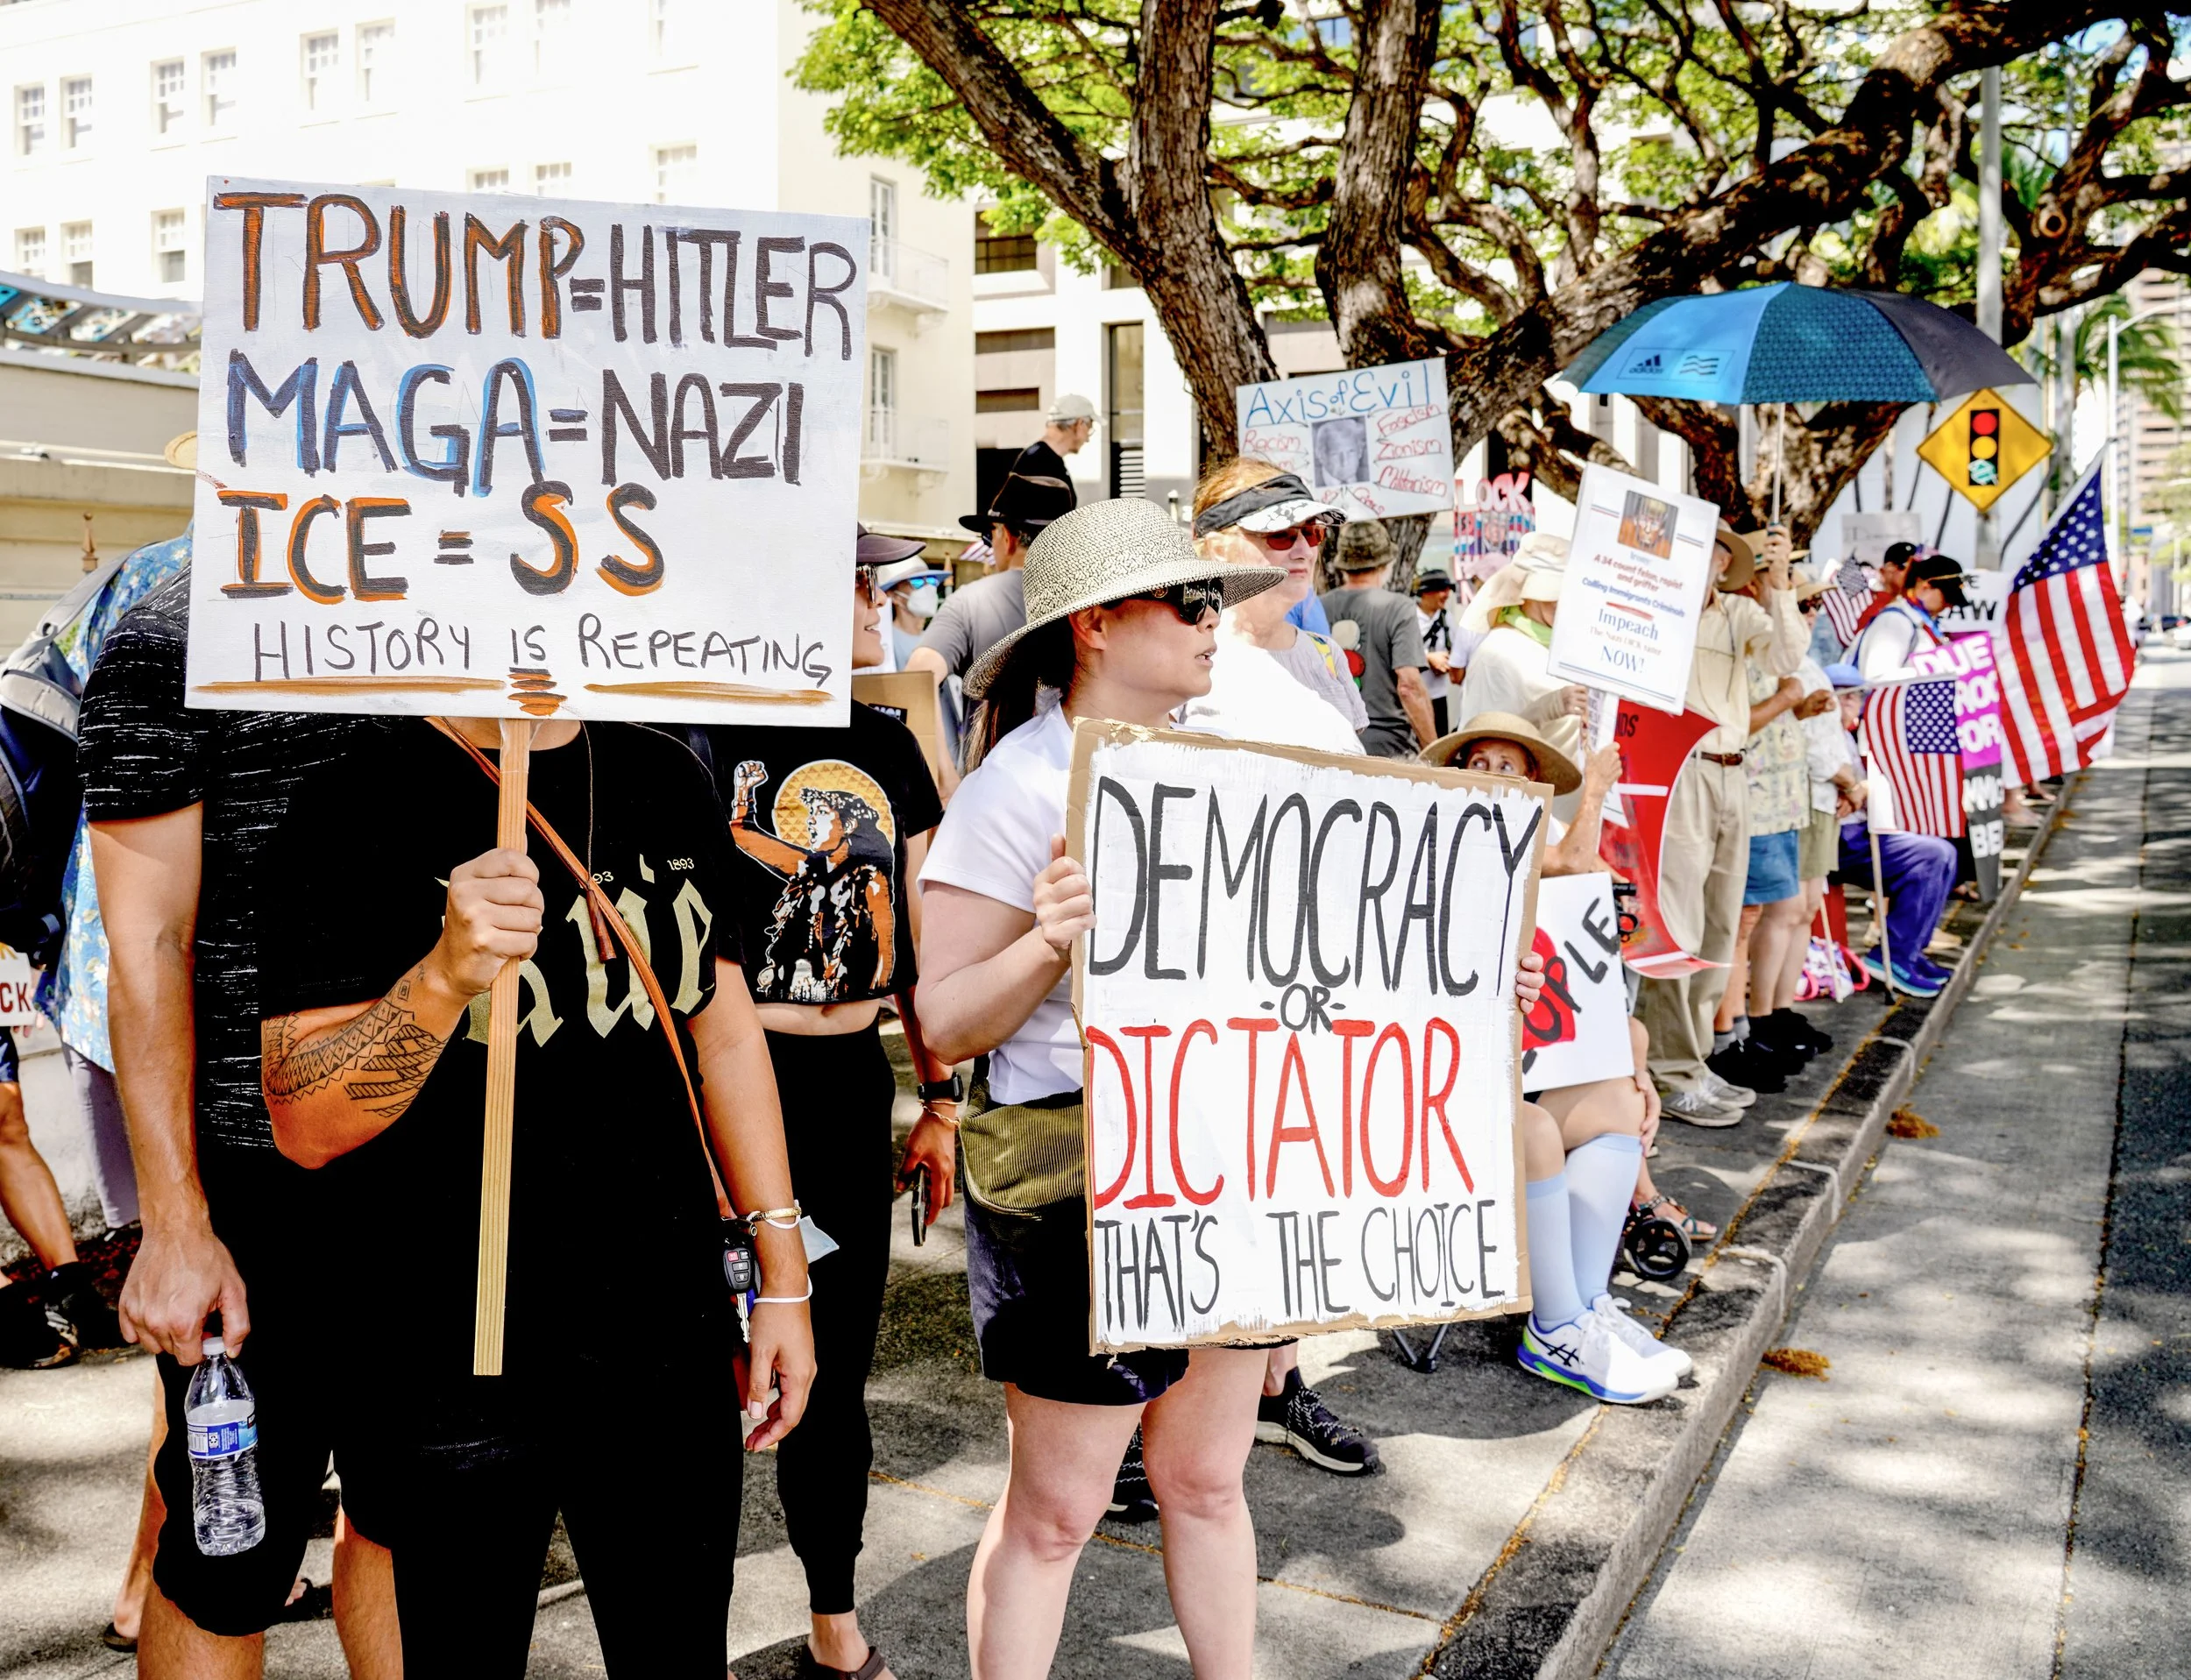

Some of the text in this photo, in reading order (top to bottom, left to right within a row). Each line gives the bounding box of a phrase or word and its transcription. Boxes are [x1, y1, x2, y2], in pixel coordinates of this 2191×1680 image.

[1245, 362, 1429, 428] Axis of Evil
[1377, 403, 1443, 435] Fascism
[1377, 438, 1443, 461] Zionism
[1455, 472, 1534, 513] LOCK
[217, 489, 413, 605] ICE
[1601, 556, 1613, 567] 34
[1598, 607, 1659, 641] Impeach
[1938, 600, 1997, 621] AW
[254, 613, 833, 683] HISTORY IS REPEATING
[1600, 645, 1645, 674] NOW!
[1911, 635, 1994, 677] DUE
[667, 857, 695, 871] 1893
[1088, 776, 1544, 997] DEMOCRACY
[1522, 897, 1620, 1074] OPLE
[1085, 1016, 1474, 1211] DICTATOR
[1094, 1199, 1507, 1332] THAT'S THE CHOICE
